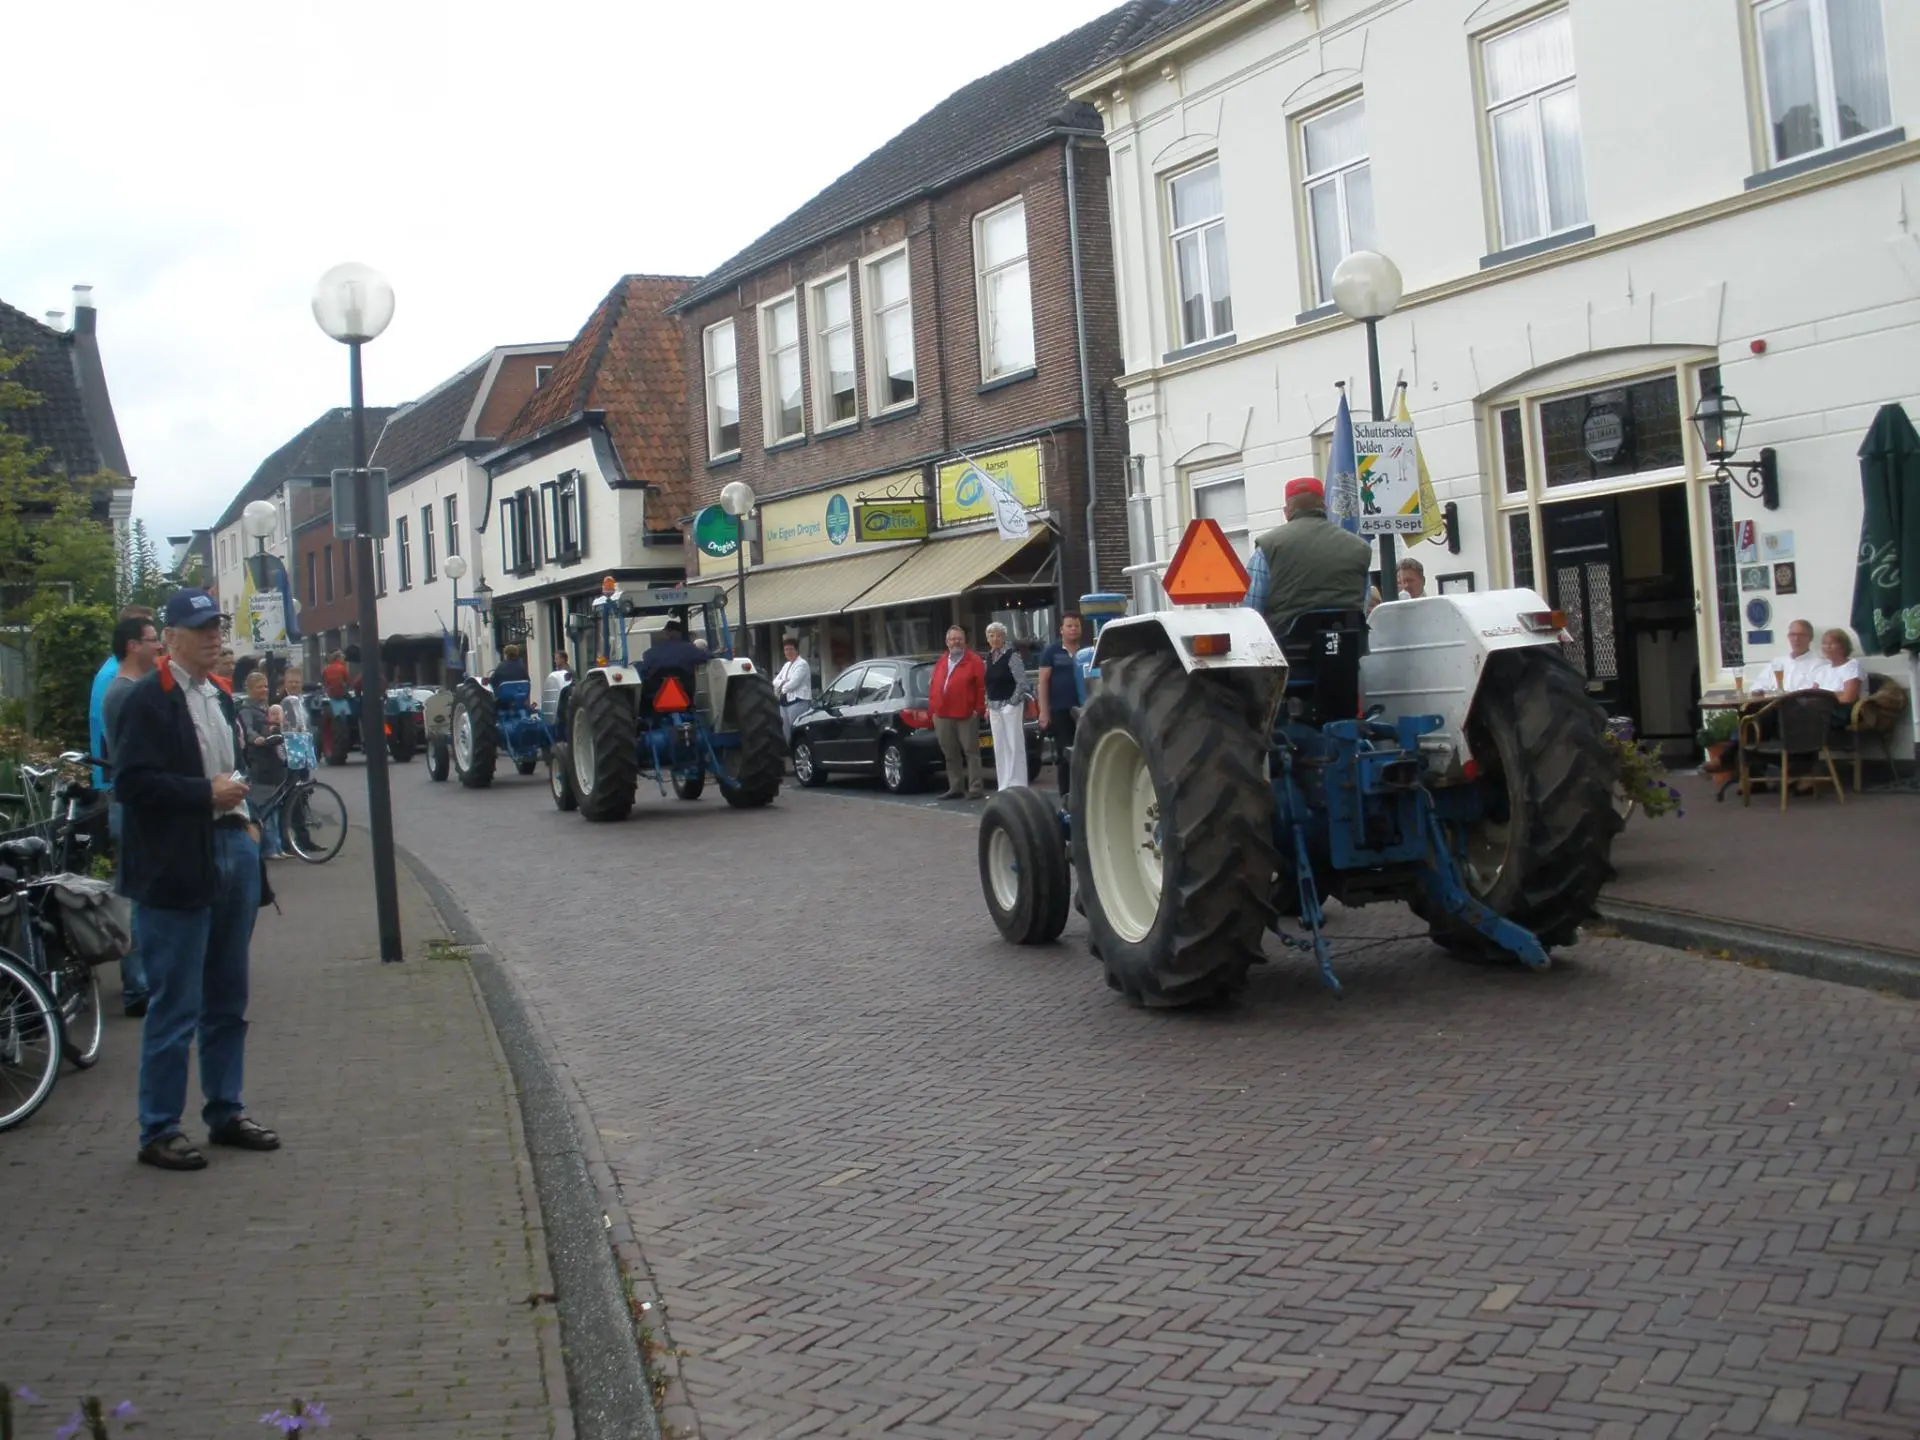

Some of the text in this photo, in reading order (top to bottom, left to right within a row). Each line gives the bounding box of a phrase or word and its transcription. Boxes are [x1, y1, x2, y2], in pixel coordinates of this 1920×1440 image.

[1356, 440, 1384, 453] Delden
[985, 461, 1009, 471] Aarsen
[779, 527, 796, 541] Eigen
[797, 521, 821, 537] Drogist
[1362, 519, 1423, 531] 4-5-6 Sept
[708, 540, 736, 554] Drogist
